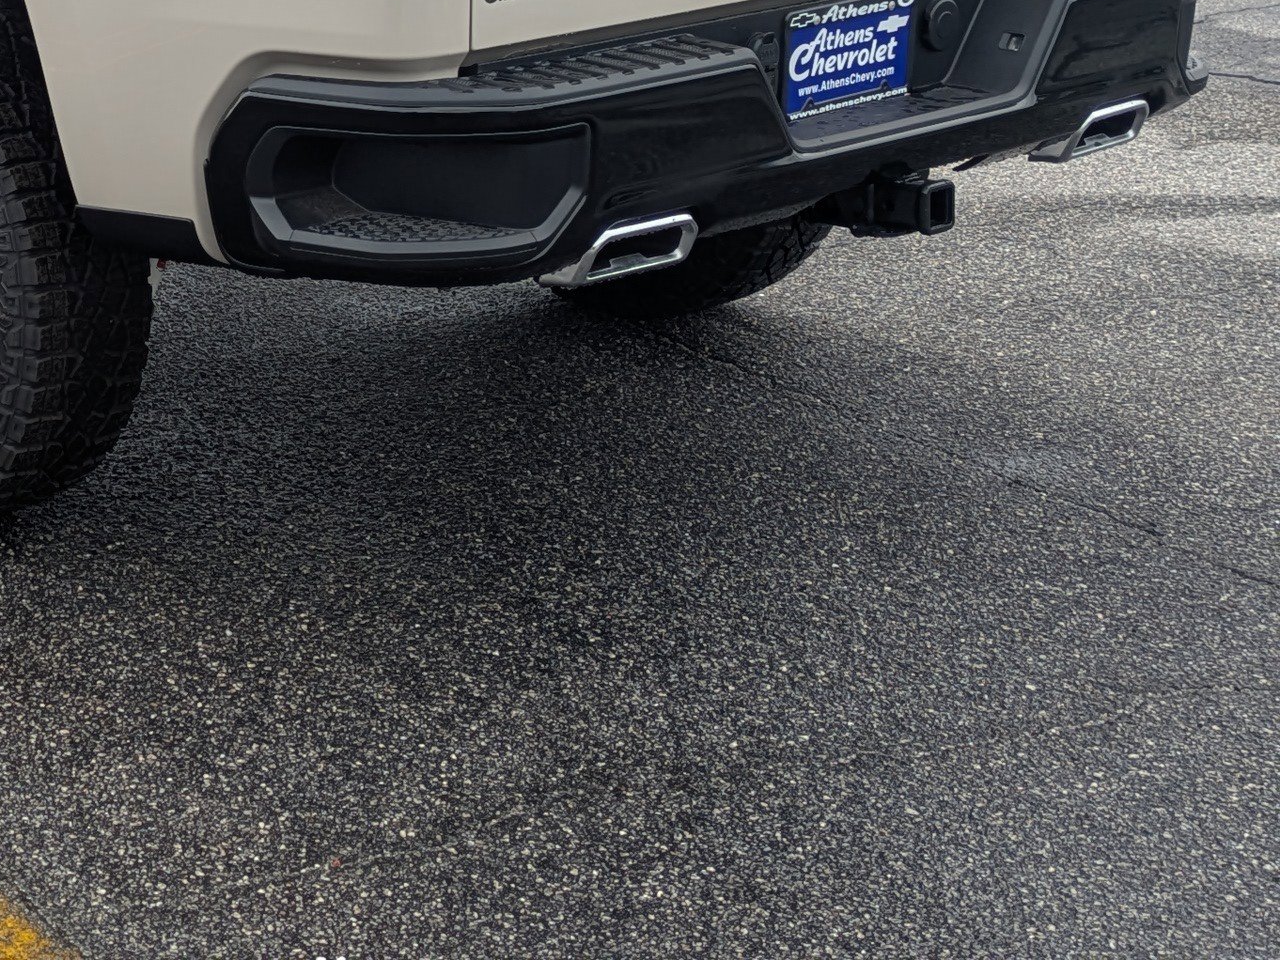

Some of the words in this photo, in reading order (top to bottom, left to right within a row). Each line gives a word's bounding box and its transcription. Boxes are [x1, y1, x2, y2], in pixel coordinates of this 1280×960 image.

[821, 0, 889, 25] Athens
[810, 27, 874, 53] Athens
[789, 36, 898, 82] Chevrolet
[798, 66, 895, 97] www.AthensChevy.com
[789, 86, 908, 121] www.athenschevy.com
